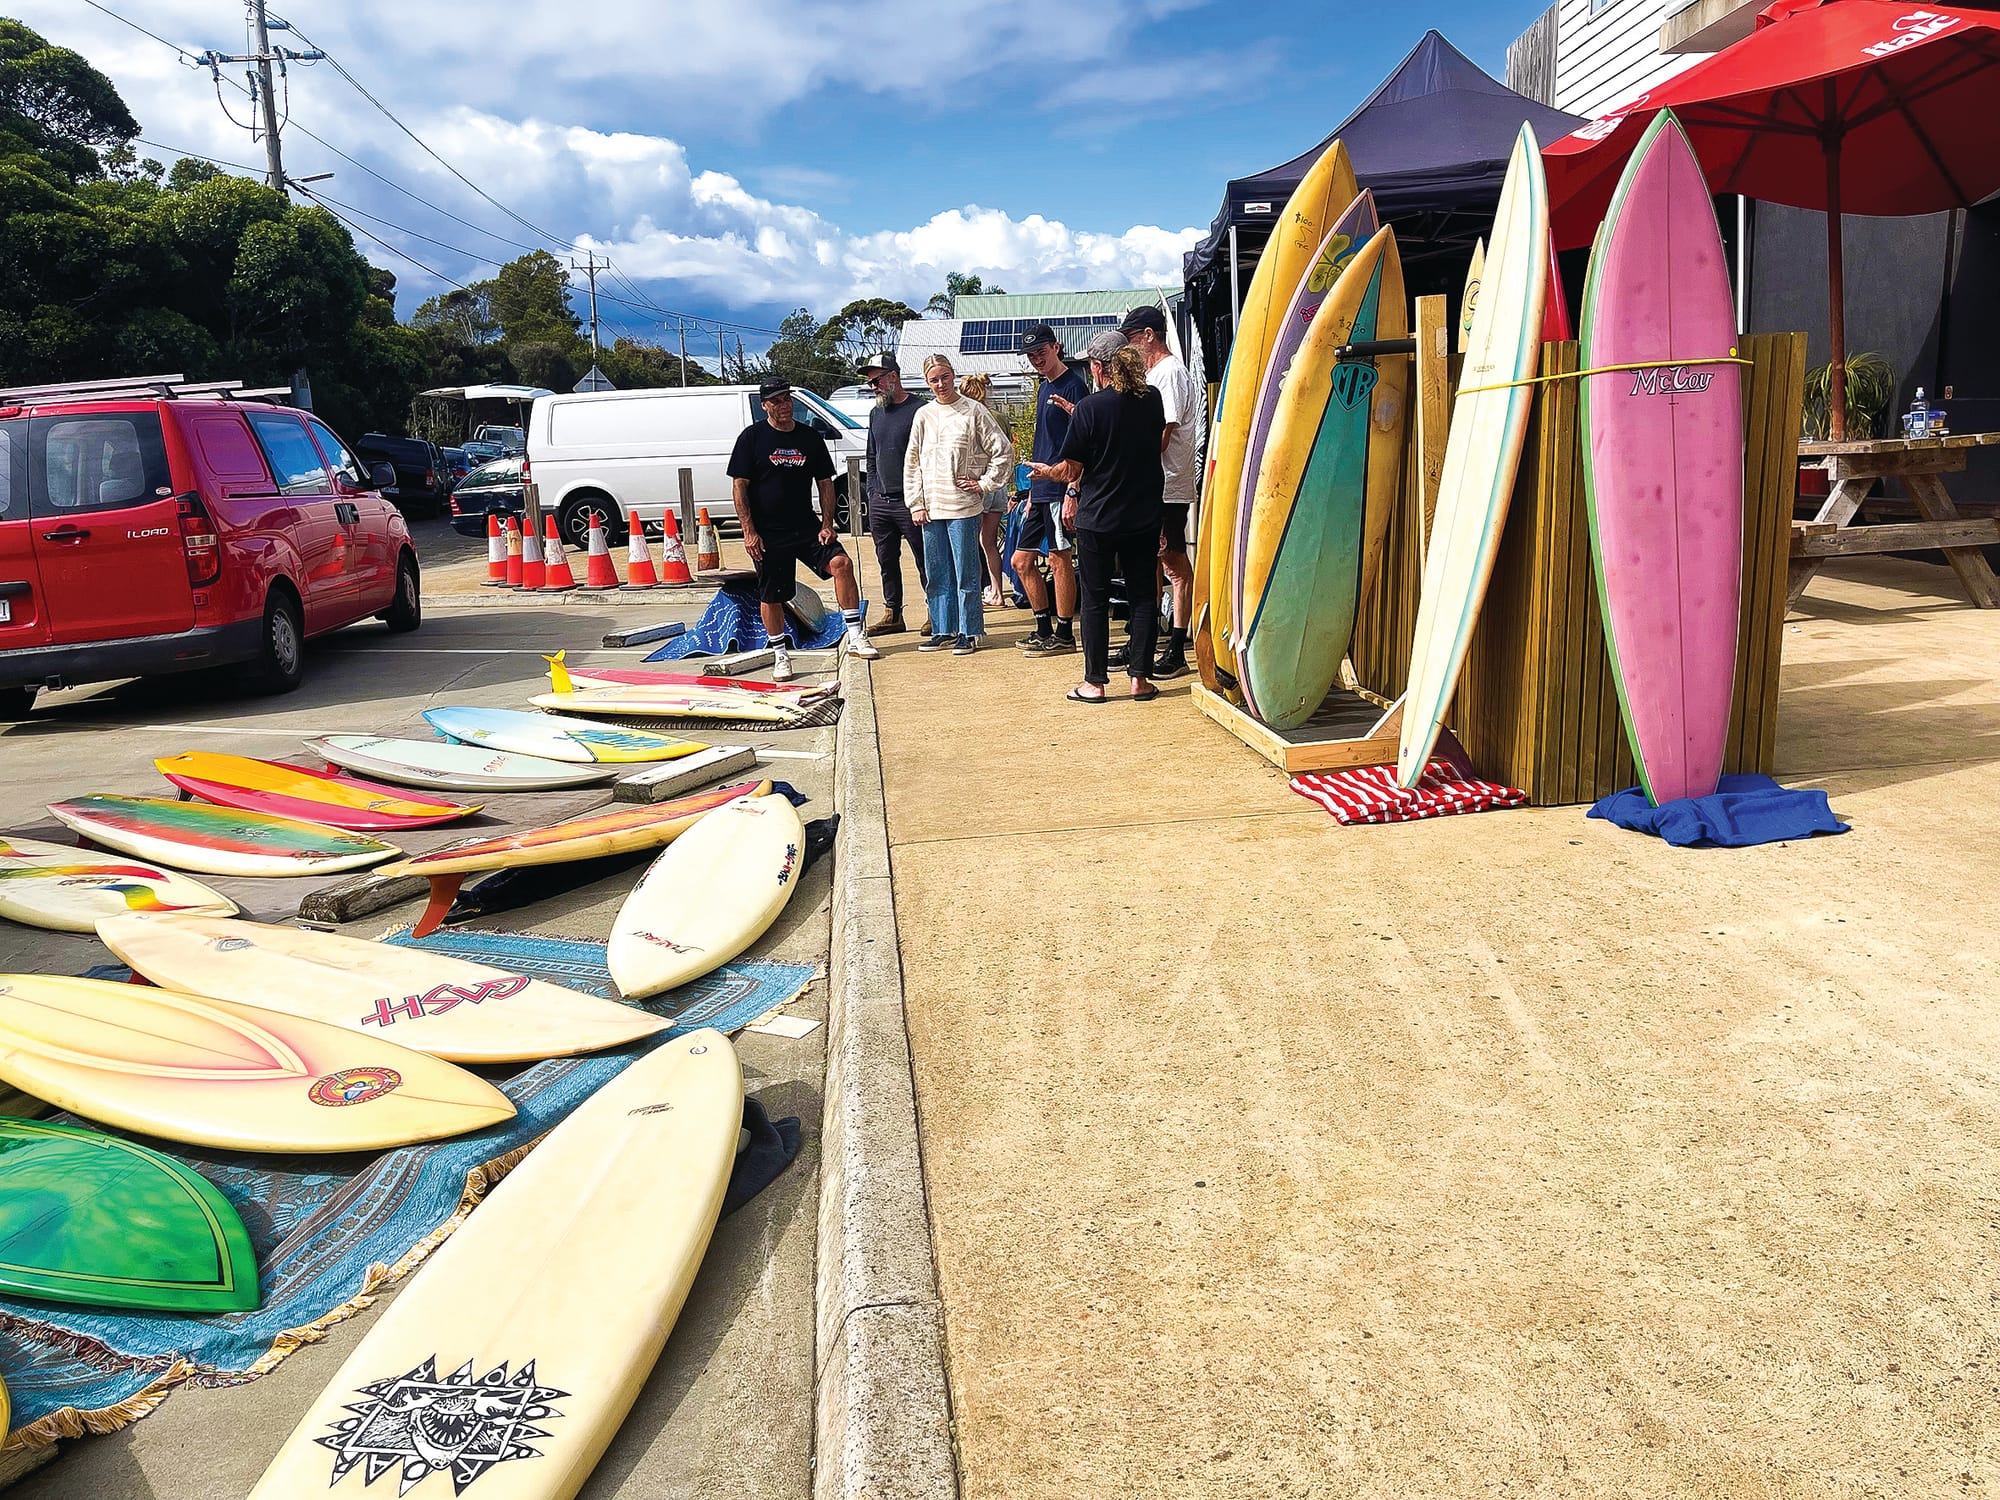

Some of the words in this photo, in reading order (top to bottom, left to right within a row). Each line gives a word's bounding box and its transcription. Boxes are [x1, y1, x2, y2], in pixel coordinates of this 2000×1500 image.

[1295, 211, 1313, 227] $100
[1339, 316, 1366, 335] $250
[1629, 366, 1715, 397] McCoy
